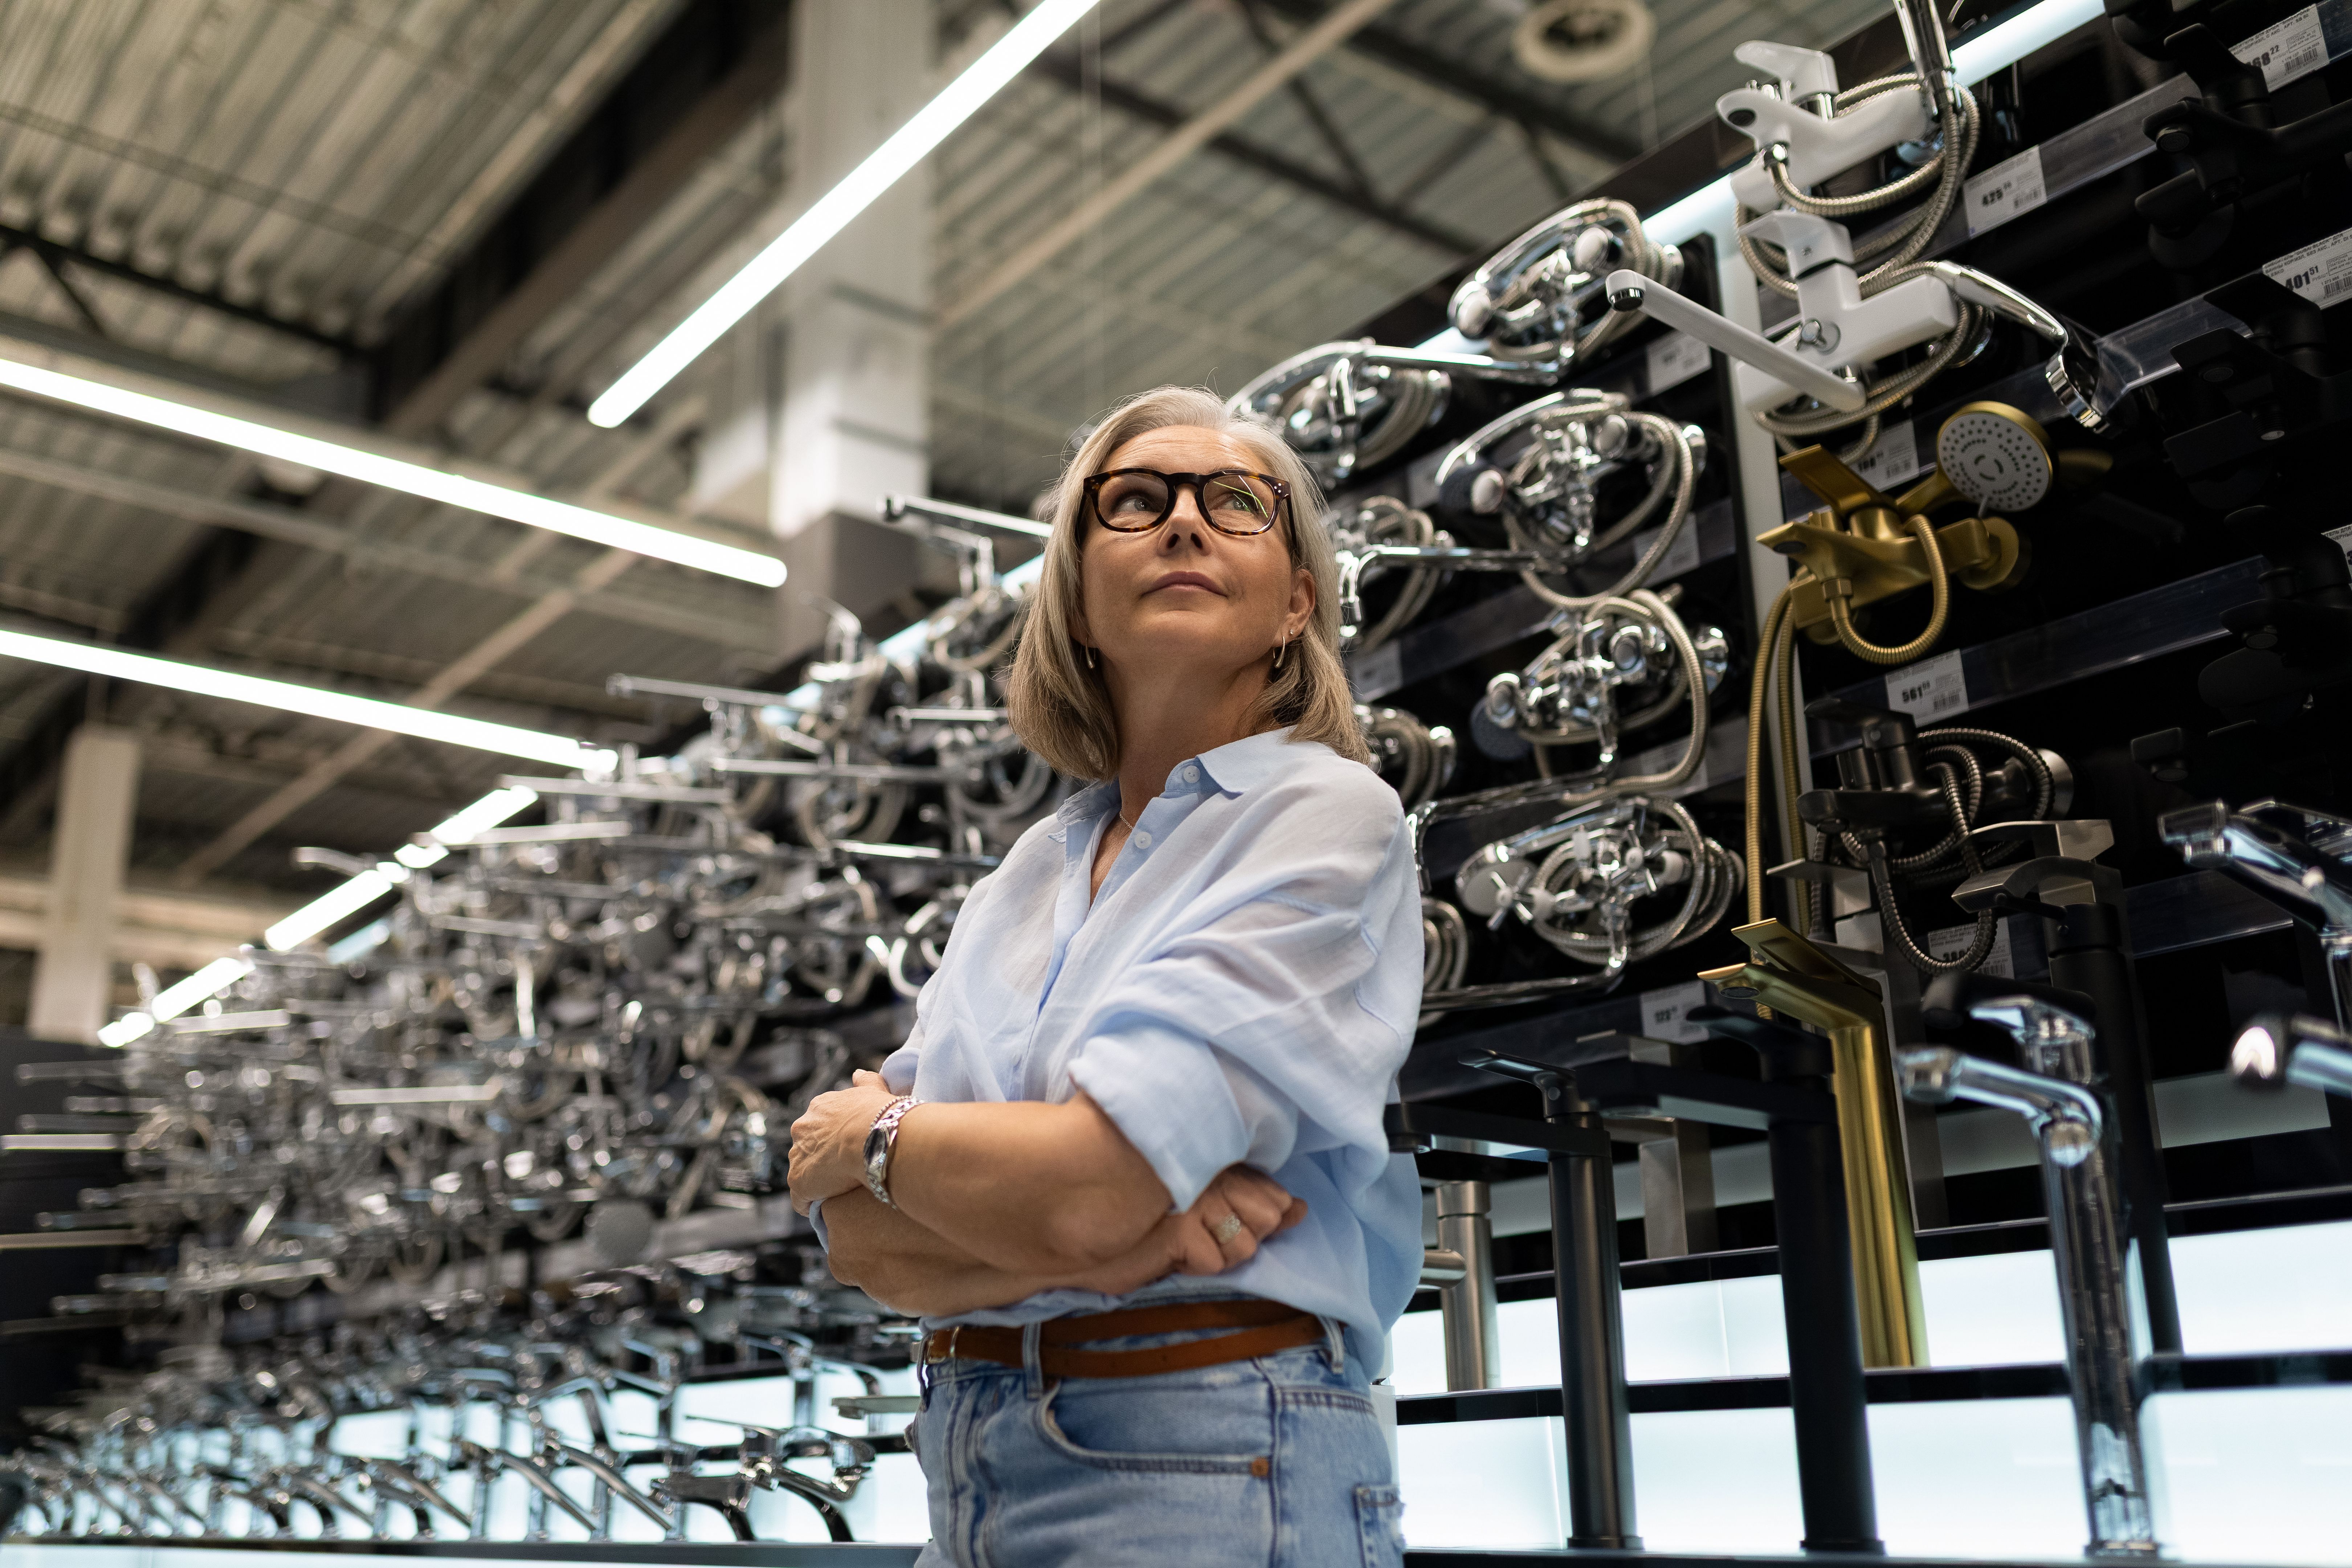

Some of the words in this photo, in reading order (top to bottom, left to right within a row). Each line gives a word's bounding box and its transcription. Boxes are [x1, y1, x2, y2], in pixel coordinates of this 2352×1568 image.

[2246, 52, 2270, 67] 68
[2286, 271, 2310, 291] 401
[2309, 265, 2319, 275] 51
